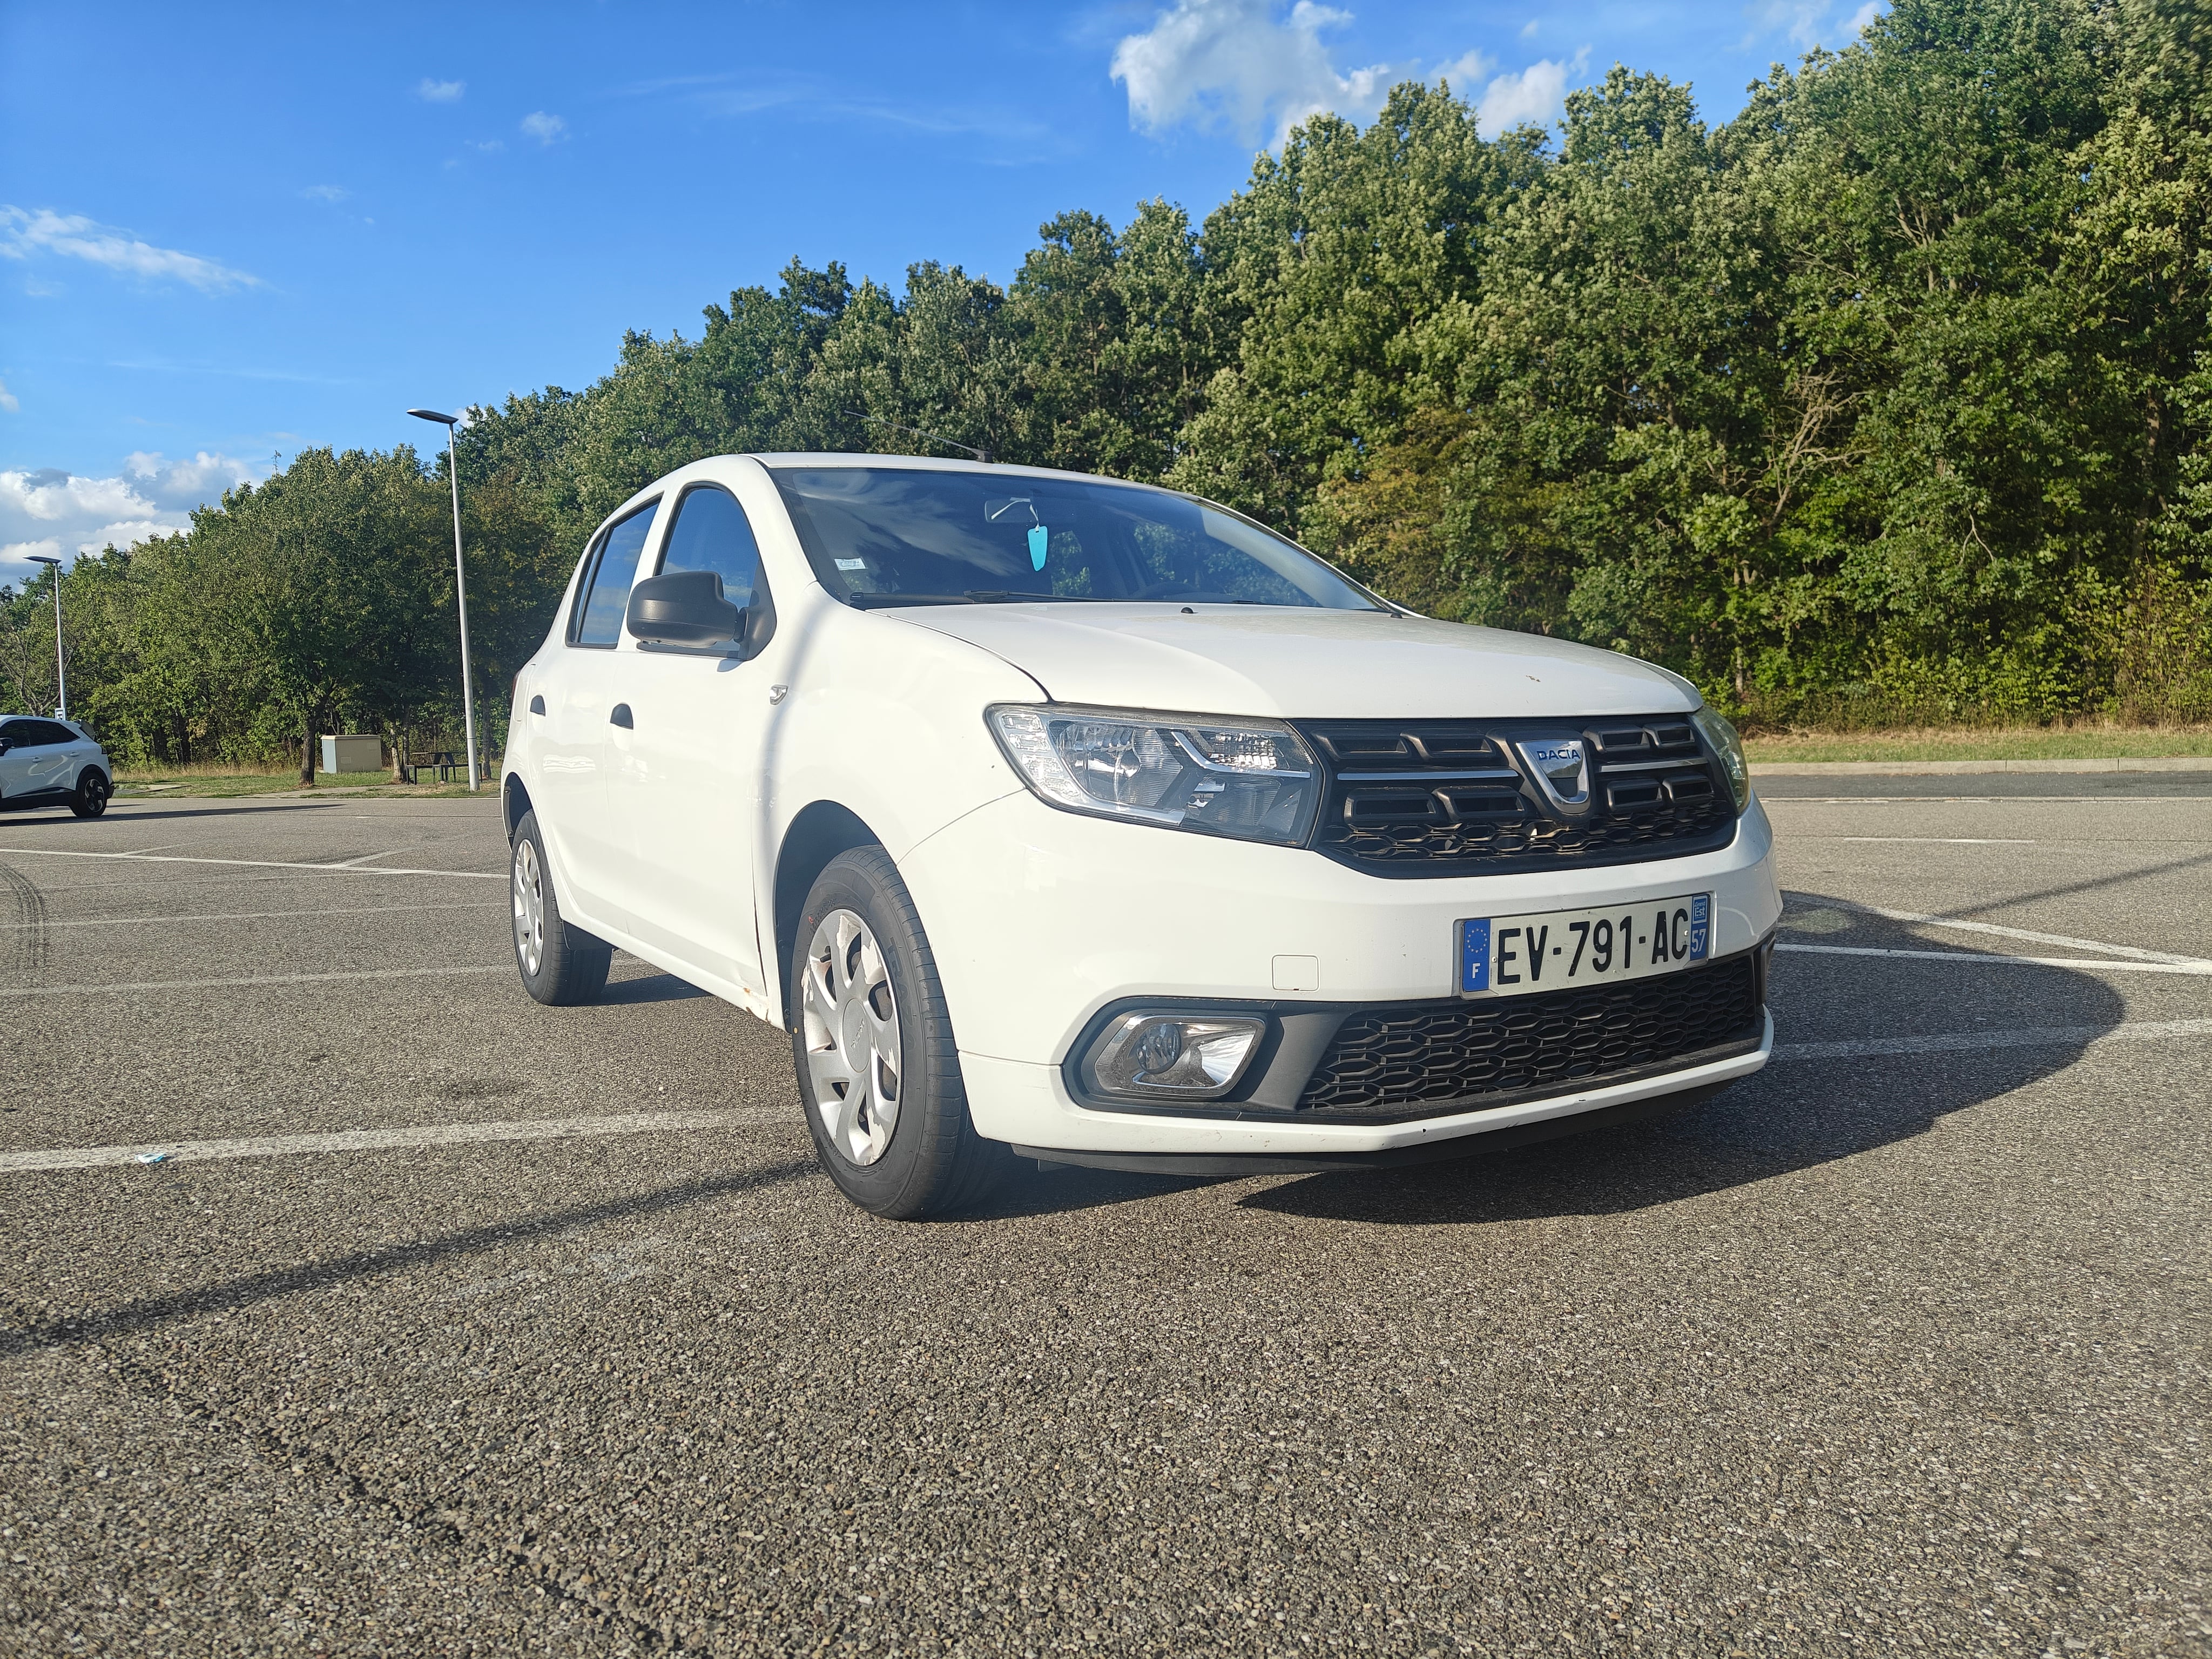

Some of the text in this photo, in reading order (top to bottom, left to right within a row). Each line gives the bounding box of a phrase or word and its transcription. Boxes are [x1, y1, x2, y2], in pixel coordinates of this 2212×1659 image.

[1536, 749, 1581, 761] DACIA
[1695, 906, 1705, 917] Est
[1498, 908, 1689, 984] EV-791-AC
[1691, 928, 1707, 953] 57
[1472, 963, 1481, 979] F
